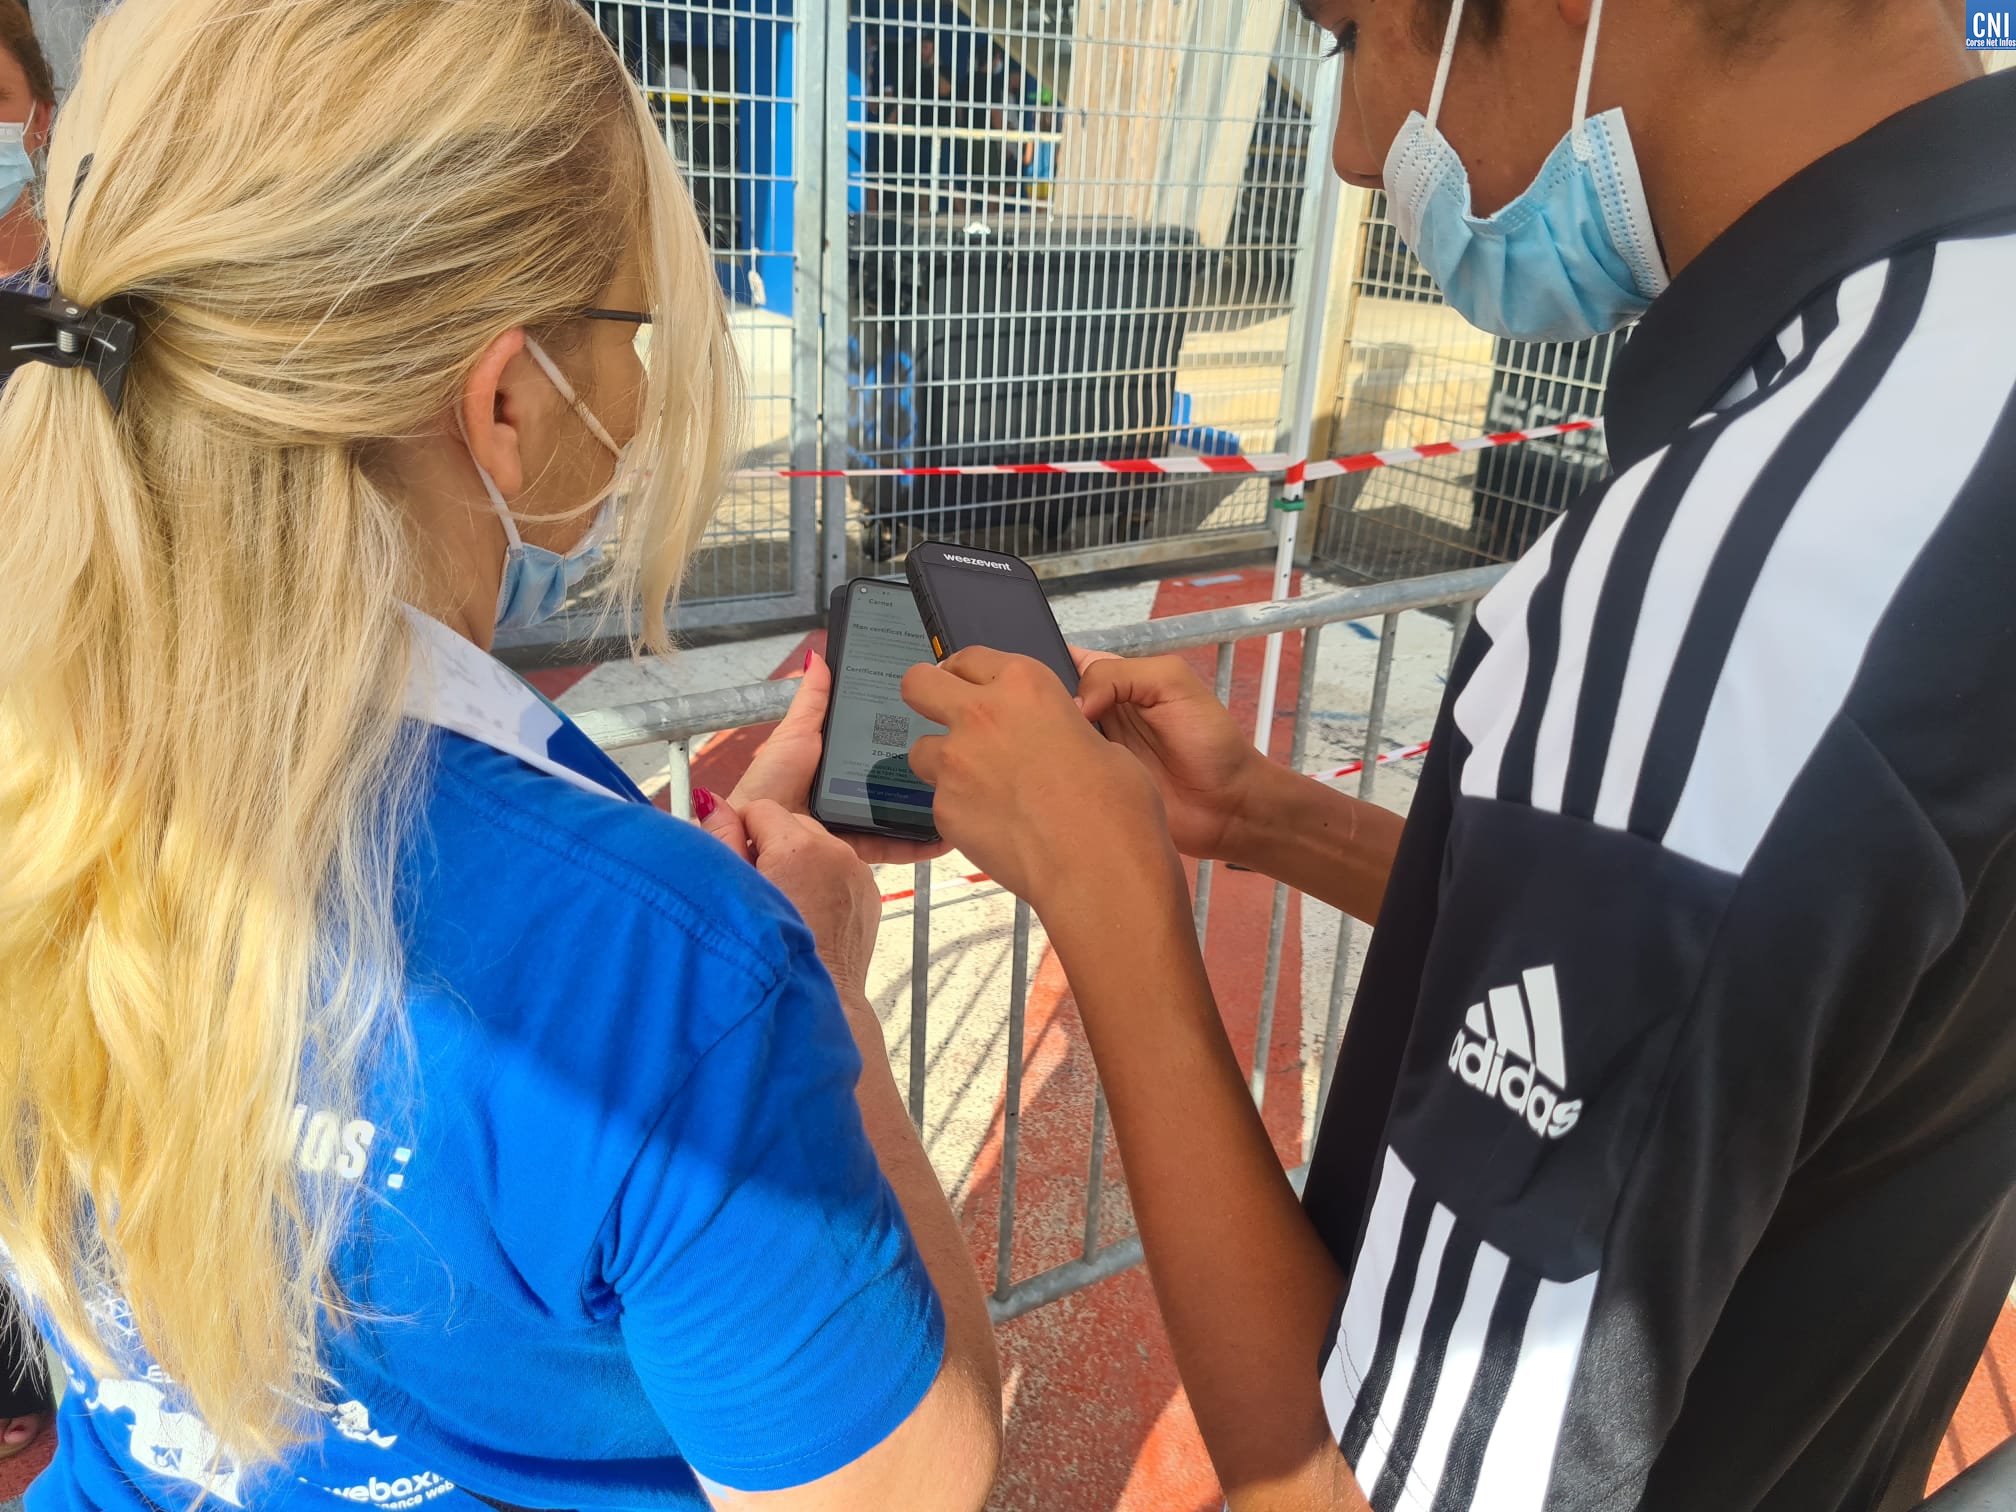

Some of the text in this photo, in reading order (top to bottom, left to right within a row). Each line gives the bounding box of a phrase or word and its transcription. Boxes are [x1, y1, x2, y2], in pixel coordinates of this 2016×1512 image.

[943, 553, 1012, 571] weezevent
[1448, 1028, 1583, 1139] adidas
[426, 1481, 455, 1500] web
